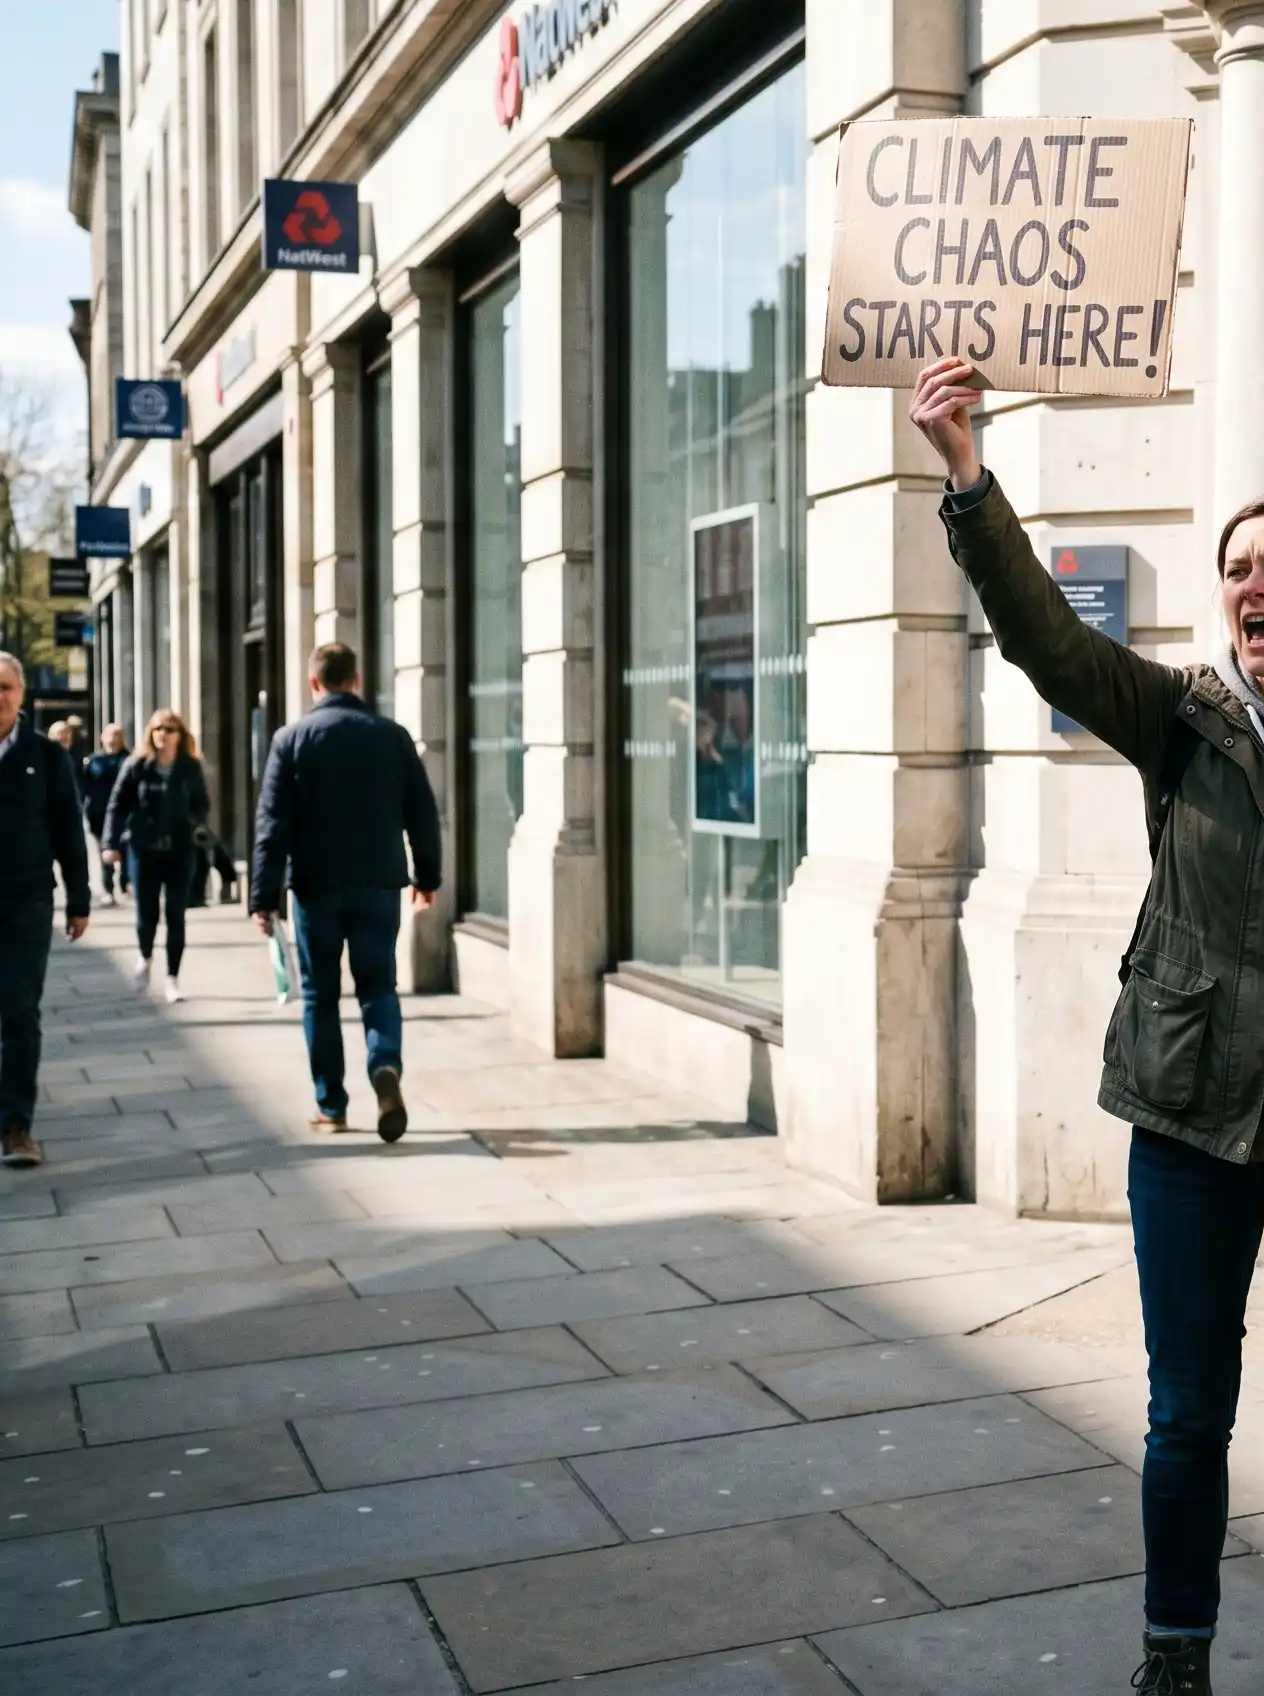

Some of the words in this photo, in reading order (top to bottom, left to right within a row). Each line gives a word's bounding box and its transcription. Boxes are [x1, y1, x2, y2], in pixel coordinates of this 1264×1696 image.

[866, 134, 1128, 208] CLIMATE
[277, 247, 348, 267] NatWest
[894, 216, 1090, 291] CHAOS
[839, 297, 998, 363] STARTS
[1018, 299, 1168, 379] HERE!
